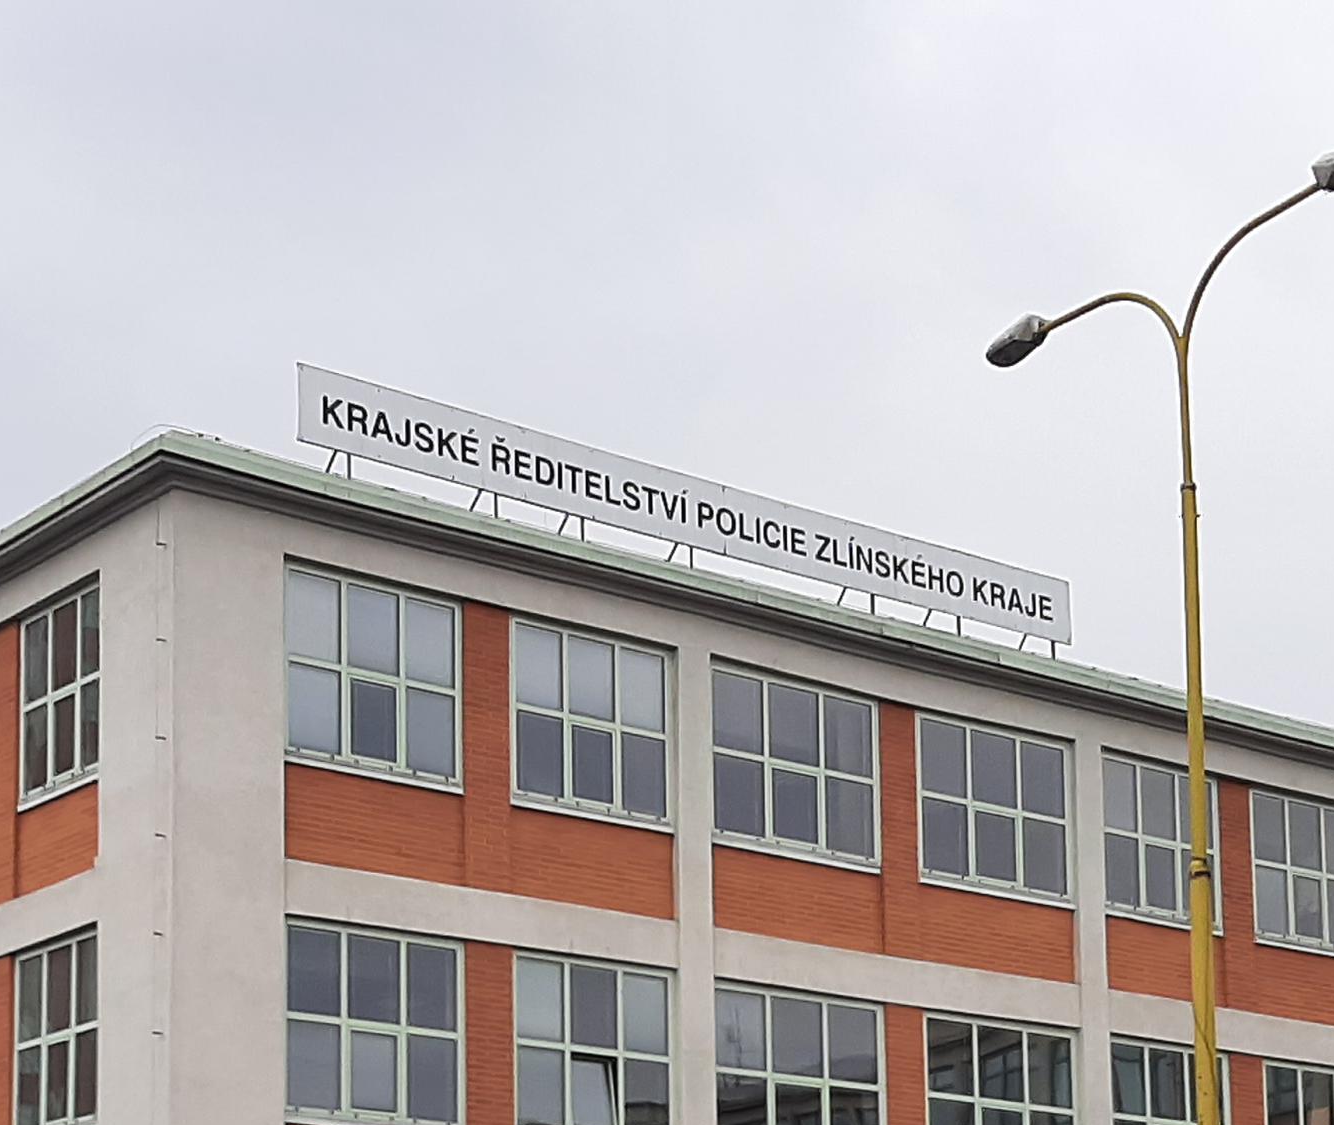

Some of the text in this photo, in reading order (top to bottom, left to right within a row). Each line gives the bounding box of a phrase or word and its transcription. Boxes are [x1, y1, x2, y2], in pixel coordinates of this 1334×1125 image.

[321, 395, 1054, 622] KRAJSKÉ ŘEDITELSTVÍ POLICIE ZLÍNSKÉHO KRAJE
